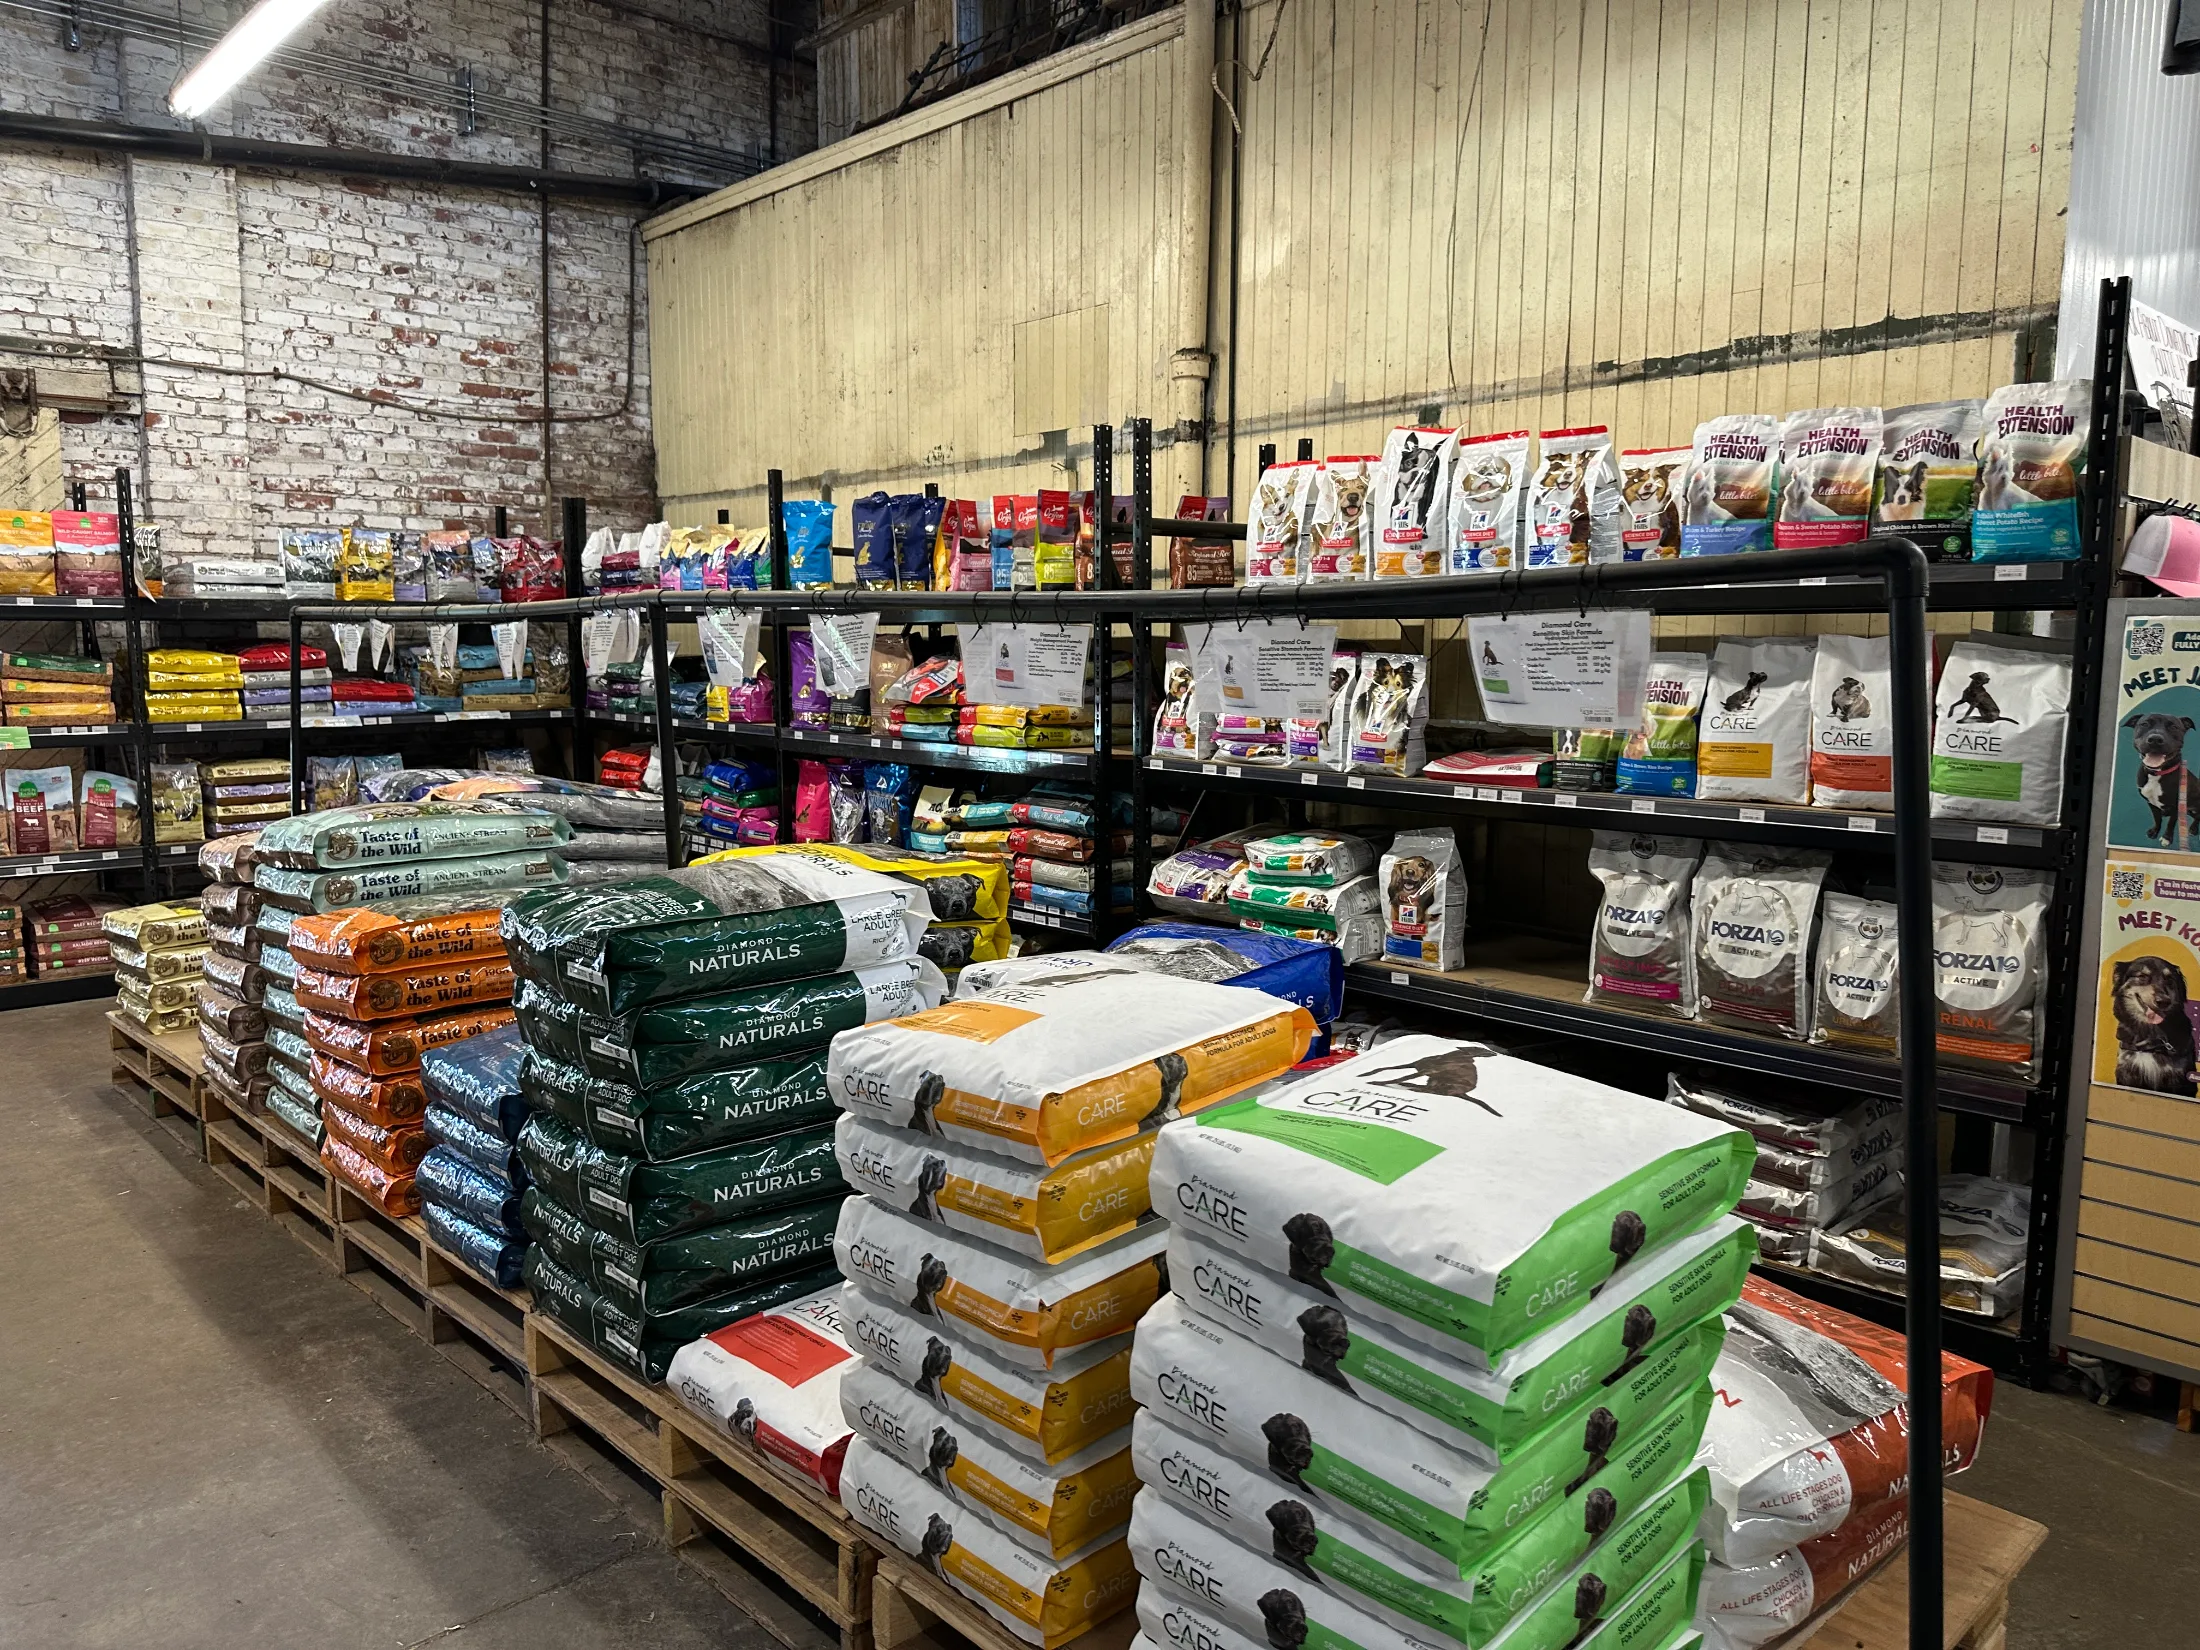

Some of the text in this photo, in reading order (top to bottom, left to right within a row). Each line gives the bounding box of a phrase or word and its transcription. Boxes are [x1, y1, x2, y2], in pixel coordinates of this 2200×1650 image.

[2005, 405, 2063, 417] HEALTH
[1808, 427, 1860, 440] HEALTH
[1905, 429, 1952, 445] HEALTH
[1998, 415, 2075, 439] EXTENSION
[1710, 434, 1759, 445] HEALTH
[1797, 438, 1868, 458] EXTENSION
[1704, 444, 1767, 463] EXTENSION
[1893, 441, 1960, 462] EXTENSION
[1841, 522, 1863, 531] Recipe
[2174, 641, 2199, 649] FULLY
[2123, 667, 2181, 698] MEET
[1710, 716, 1757, 730] CARE
[1821, 731, 1872, 747] CARE
[1946, 733, 2002, 753] CARE
[16, 805, 44, 813] BEEF
[359, 827, 419, 844] Taste of
[361, 841, 422, 858] the Wild
[360, 869, 420, 888] Taste of
[433, 868, 507, 881] ANCIENT STREAM
[360, 884, 421, 902] the Wild
[851, 908, 906, 924] LARGE BREE
[863, 920, 892, 932] ADULT
[2118, 910, 2177, 931] MEET
[176, 932, 196, 941] the
[404, 922, 472, 943] Taste of
[1711, 920, 1785, 946] FORZA10
[407, 939, 474, 959] the Wild
[566, 942, 597, 958] ADULT DOG
[717, 936, 774, 952] DIAMOND
[1731, 946, 1760, 957] ACTIVE
[183, 964, 203, 973] the
[689, 943, 801, 974] NATURALS
[404, 969, 471, 991] Taste of
[900, 979, 916, 989] BREE
[1829, 973, 1889, 992] FORZA10
[1953, 976, 1989, 987] ACTIVE
[406, 985, 473, 1006] the Wild
[1846, 993, 1875, 1003] ACTIVE
[746, 1011, 799, 1027] DIAMOND
[1940, 1011, 1997, 1031] RENAL
[420, 1020, 483, 1045] Taste of
[719, 1016, 824, 1049] NATURALS
[1206, 1026, 1277, 1057] FORMULA FOR ADULT DOGS
[844, 1074, 893, 1107] CARE
[1077, 1093, 1127, 1126] CARE
[1303, 1091, 1430, 1123] CARE
[526, 1136, 572, 1171] NATURALS
[590, 1167, 622, 1187] ADULT DOG
[1191, 1174, 1238, 1201] Diamond
[1658, 1156, 1721, 1200] SENSITIVE SKIN FORMULA
[1662, 1187, 1692, 1212] FOR ADULT
[1177, 1182, 1250, 1239] CARE
[758, 1229, 810, 1249] DIAMOND
[732, 1233, 834, 1274] NATURALS
[1872, 1256, 1907, 1269] FORZA
[548, 1261, 577, 1284] DIAMOND
[850, 1244, 896, 1285] CARE
[1206, 1258, 1252, 1288] Diamond
[1668, 1247, 1727, 1293] SENSITIVE FORMULA
[534, 1262, 582, 1308] NATURALS
[1525, 1270, 1580, 1318] CARE
[1672, 1281, 1699, 1305] FOR ADULT
[1193, 1265, 1263, 1328] CARE
[603, 1309, 623, 1324] ADULT
[1070, 1293, 1122, 1332] CARE
[1170, 1365, 1219, 1395] Diamond
[681, 1381, 718, 1418] CARE
[1157, 1372, 1229, 1434] CARE
[1759, 1473, 1843, 1509] ALL LIFE STAGES DOG
[1812, 1488, 1839, 1507] CHICKEN
[856, 1487, 902, 1537] CARE
[1866, 1510, 1903, 1544] DIAMOND
[1848, 1520, 1909, 1579] NATURAL
[1083, 1570, 1132, 1610] CARE
[1509, 1559, 1557, 1612] CARE
[1719, 1567, 1804, 1611] ALL LIFE STAGES DOG
[1773, 1585, 1802, 1607] CHICKEN
[1176, 1606, 1221, 1638] Diamond
